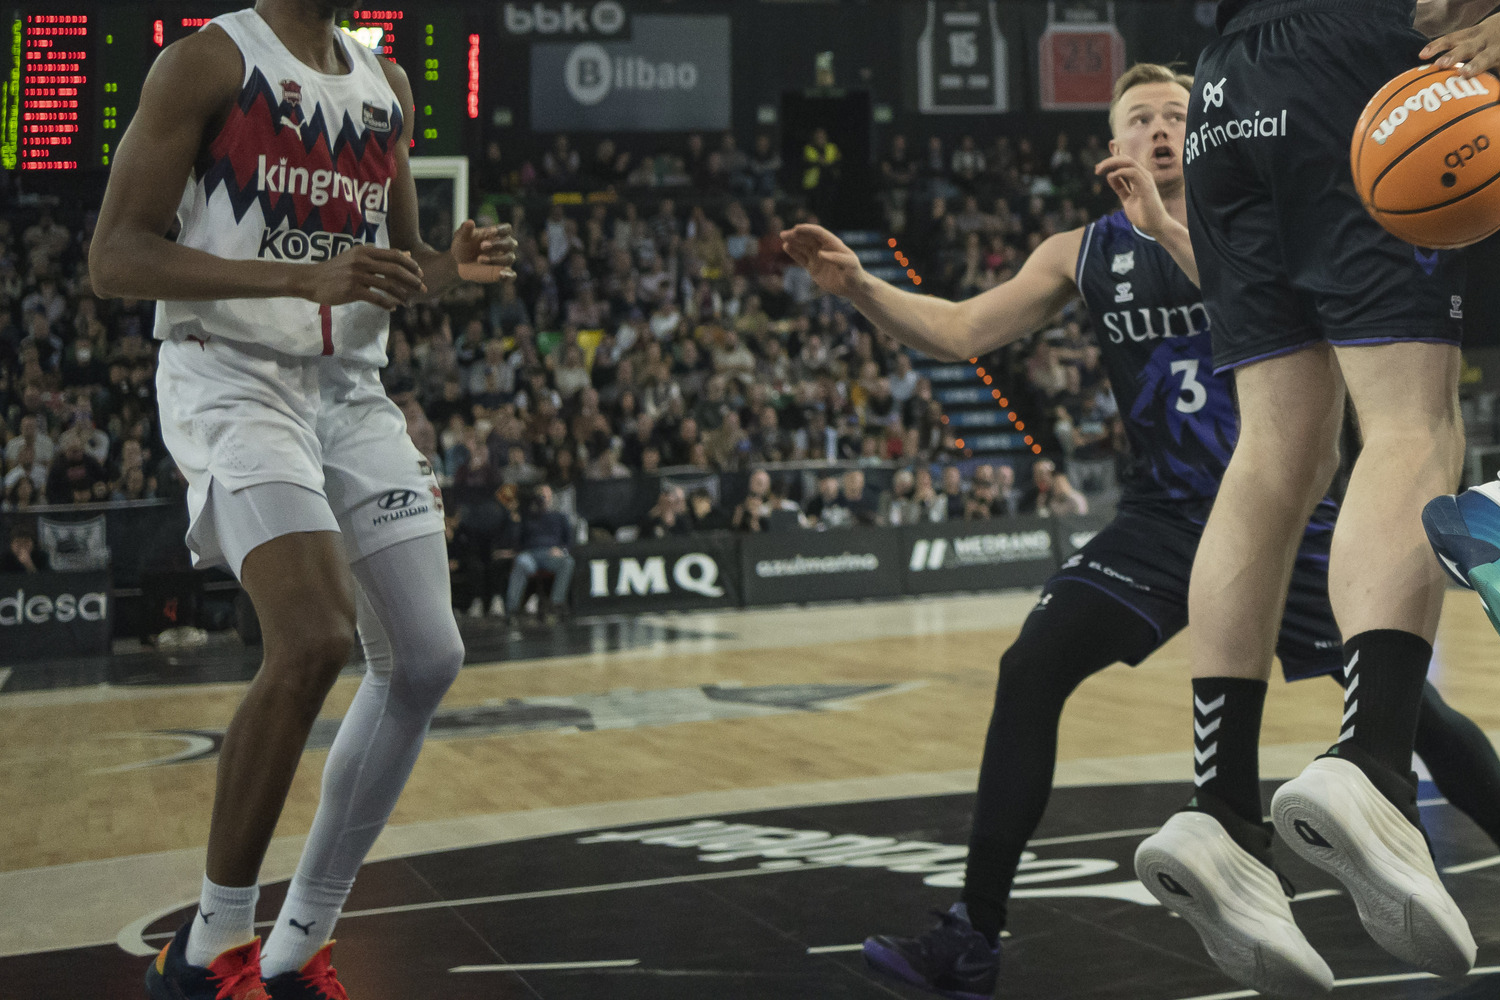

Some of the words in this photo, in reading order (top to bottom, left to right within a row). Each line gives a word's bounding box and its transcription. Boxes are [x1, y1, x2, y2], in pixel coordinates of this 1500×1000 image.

[504, 2, 590, 34] bbk
[1371, 76, 1489, 145] Wilson
[1444, 134, 1491, 169] acb
[1170, 359, 1208, 414] 3
[589, 553, 725, 598] IMQ
[0, 587, 108, 626] desa
